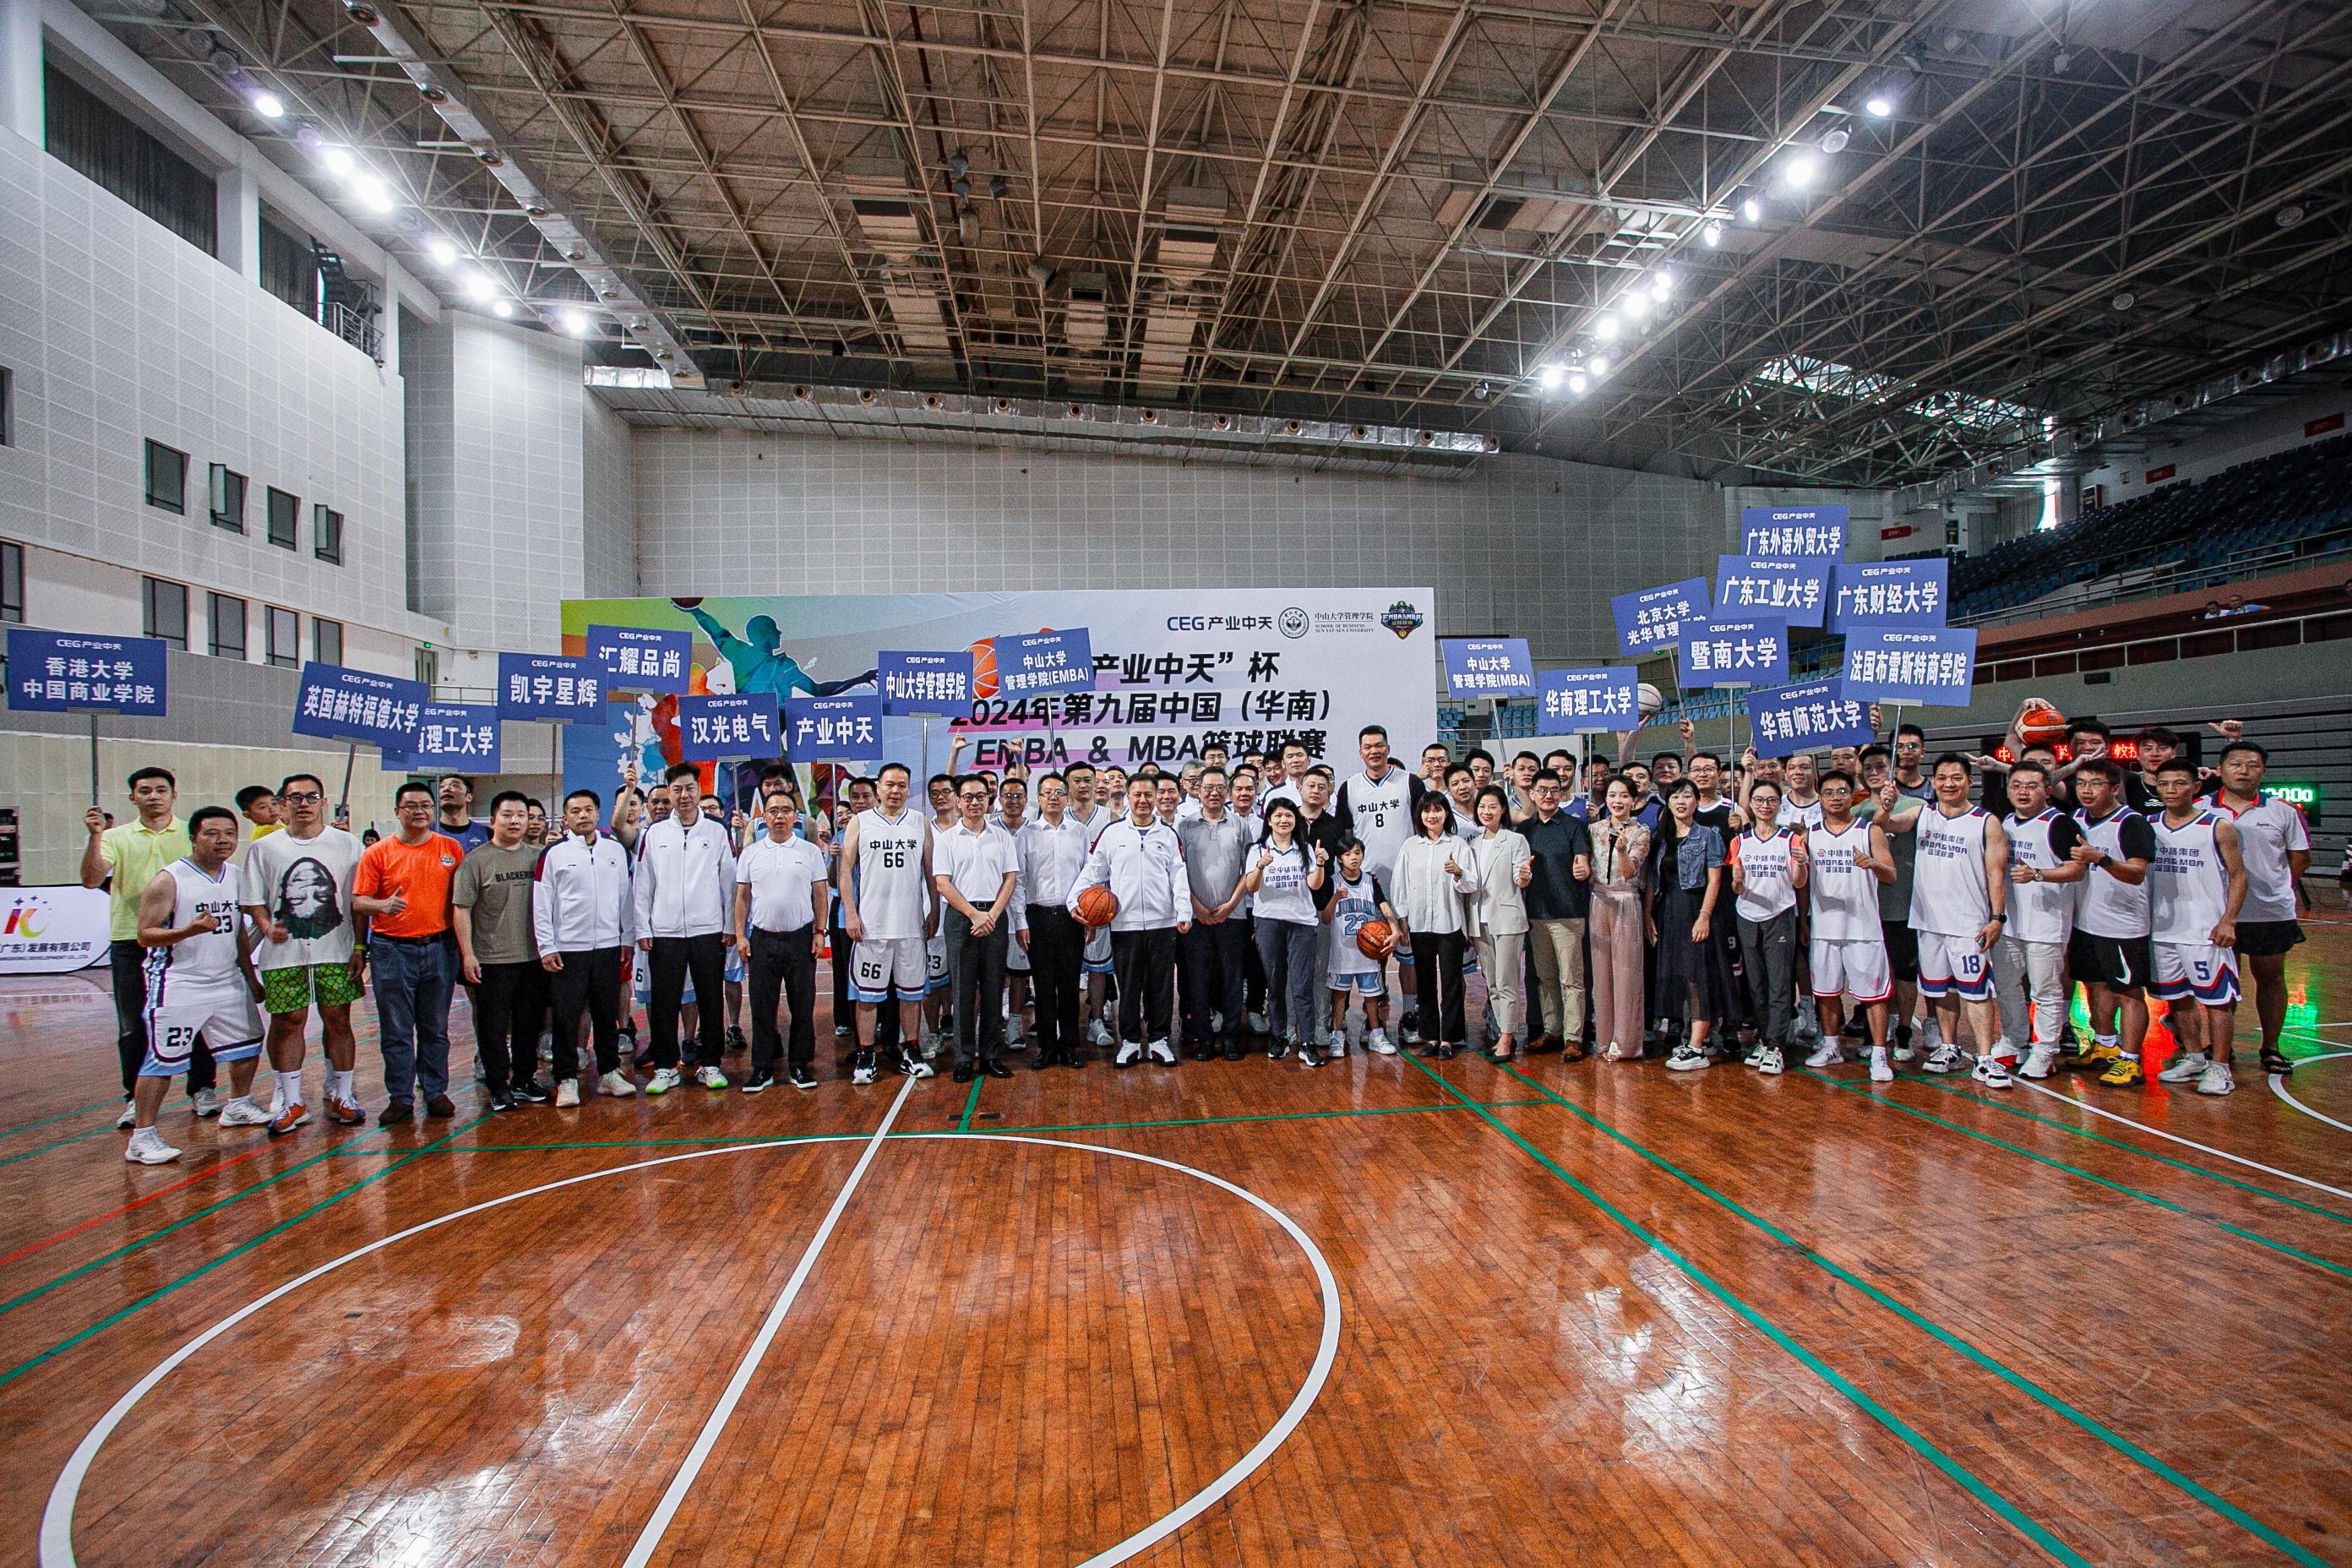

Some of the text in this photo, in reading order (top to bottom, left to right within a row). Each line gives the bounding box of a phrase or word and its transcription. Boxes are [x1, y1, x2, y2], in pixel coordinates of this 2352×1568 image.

[1746, 525, 1840, 556] 广东外语外贸大学
[1880, 567, 1911, 575] 产业中天
[1639, 589, 1679, 603] CEG 产业中天
[1723, 575, 1820, 609] 广东工业大学
[1837, 580, 1938, 616] 广东财经大学
[1637, 600, 1690, 625] 北京大学
[1167, 616, 1205, 631] CEG
[1208, 615, 1273, 631] 产业中天
[1627, 615, 1706, 645] 光华管理
[1727, 623, 1755, 632] 产业中天
[57, 640, 122, 651] CEG 产业中天
[635, 633, 662, 642] 产业中天
[1037, 636, 1062, 645] 产业中天
[1883, 634, 1937, 643] CEG 产业中天
[598, 645, 680, 678] 汇耀品尚
[1023, 650, 1067, 671] 中山大学
[1690, 637, 1778, 670] 暨南大学
[46, 656, 133, 680] 香港大学
[549, 661, 577, 669] 产业中天
[1248, 651, 1281, 683] 杯
[1467, 656, 1511, 672] 中山大学
[1849, 650, 1967, 686] 法国布雷斯特商学院
[341, 675, 394, 690] CEG 产业中天
[885, 671, 966, 701] 中山大学管理学院
[1004, 667, 1089, 691] 管理学院(EMBA)
[1452, 673, 1531, 689] 管理学院(MBA)
[23, 679, 155, 704] 中国商业学院
[510, 673, 598, 708] 凯宇星辉
[1780, 686, 1828, 700] CEG 产业中天
[303, 684, 420, 734] 英国赫特福德大学
[1545, 686, 1632, 718] 华南理工大学
[691, 712, 770, 744] 汉光电气
[797, 716, 874, 746] 产业中天
[1760, 700, 1862, 742] 华南师范大学
[418, 725, 493, 756] 理工大学
[1087, 735, 1112, 765] &
[1358, 799, 1400, 814] 中山大学
[1375, 814, 1384, 828] 8
[870, 839, 917, 850] 中山大学
[884, 852, 904, 868] 66
[2154, 857, 2204, 868] BA&MBA
[1336, 898, 1376, 918] JORDAN
[1727, 936, 1737, 949] 9
[861, 961, 882, 980] 66
[928, 955, 941, 970] 3
[1963, 954, 1981, 974] 18
[2194, 961, 2210, 981] 5
[166, 1026, 193, 1047] 23
